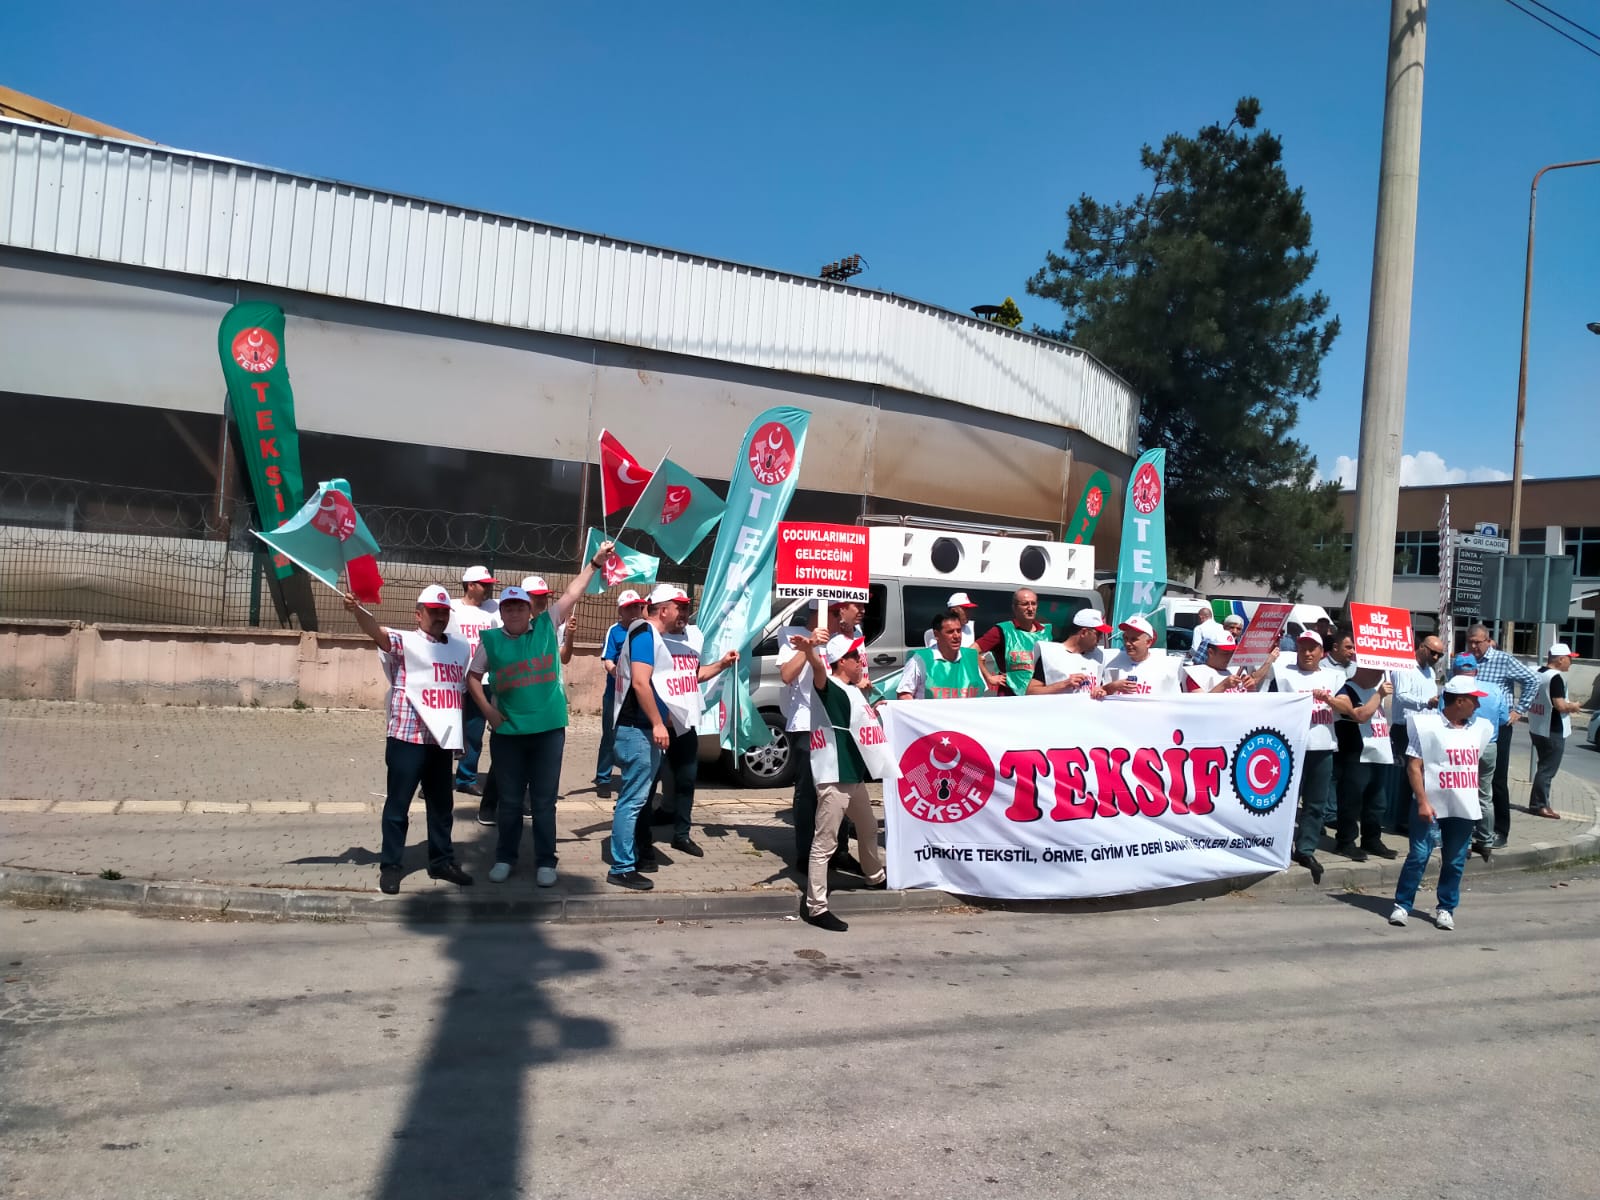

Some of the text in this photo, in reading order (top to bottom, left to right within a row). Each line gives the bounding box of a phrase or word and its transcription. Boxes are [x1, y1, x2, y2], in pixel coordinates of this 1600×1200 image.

[251, 381, 290, 528] TEKSİ
[750, 453, 787, 484] TEKSİF
[783, 529, 866, 545] ÇOCUKLARIMIZIN
[795, 548, 853, 563] GELECEĞİNİ
[795, 565, 848, 581] İSTİYORUZ
[1132, 518, 1154, 618] TEK
[778, 586, 868, 601] TEKSİF SENDİKASI
[1370, 611, 1389, 625] BİZ
[1359, 624, 1403, 639] BİRLİKTE
[1000, 729, 1227, 822] TEKSİF
[1439, 767, 1480, 789] SENDİK
[903, 787, 985, 821] TEKSİF
[914, 845, 973, 862] TÜRKİYE
[977, 847, 1038, 864] TEKSTİL,
[1042, 846, 1087, 863] ÖRME,
[1091, 844, 1123, 861] GİYİM
[1127, 844, 1140, 857] VE
[1141, 838, 1163, 855] DERİ
